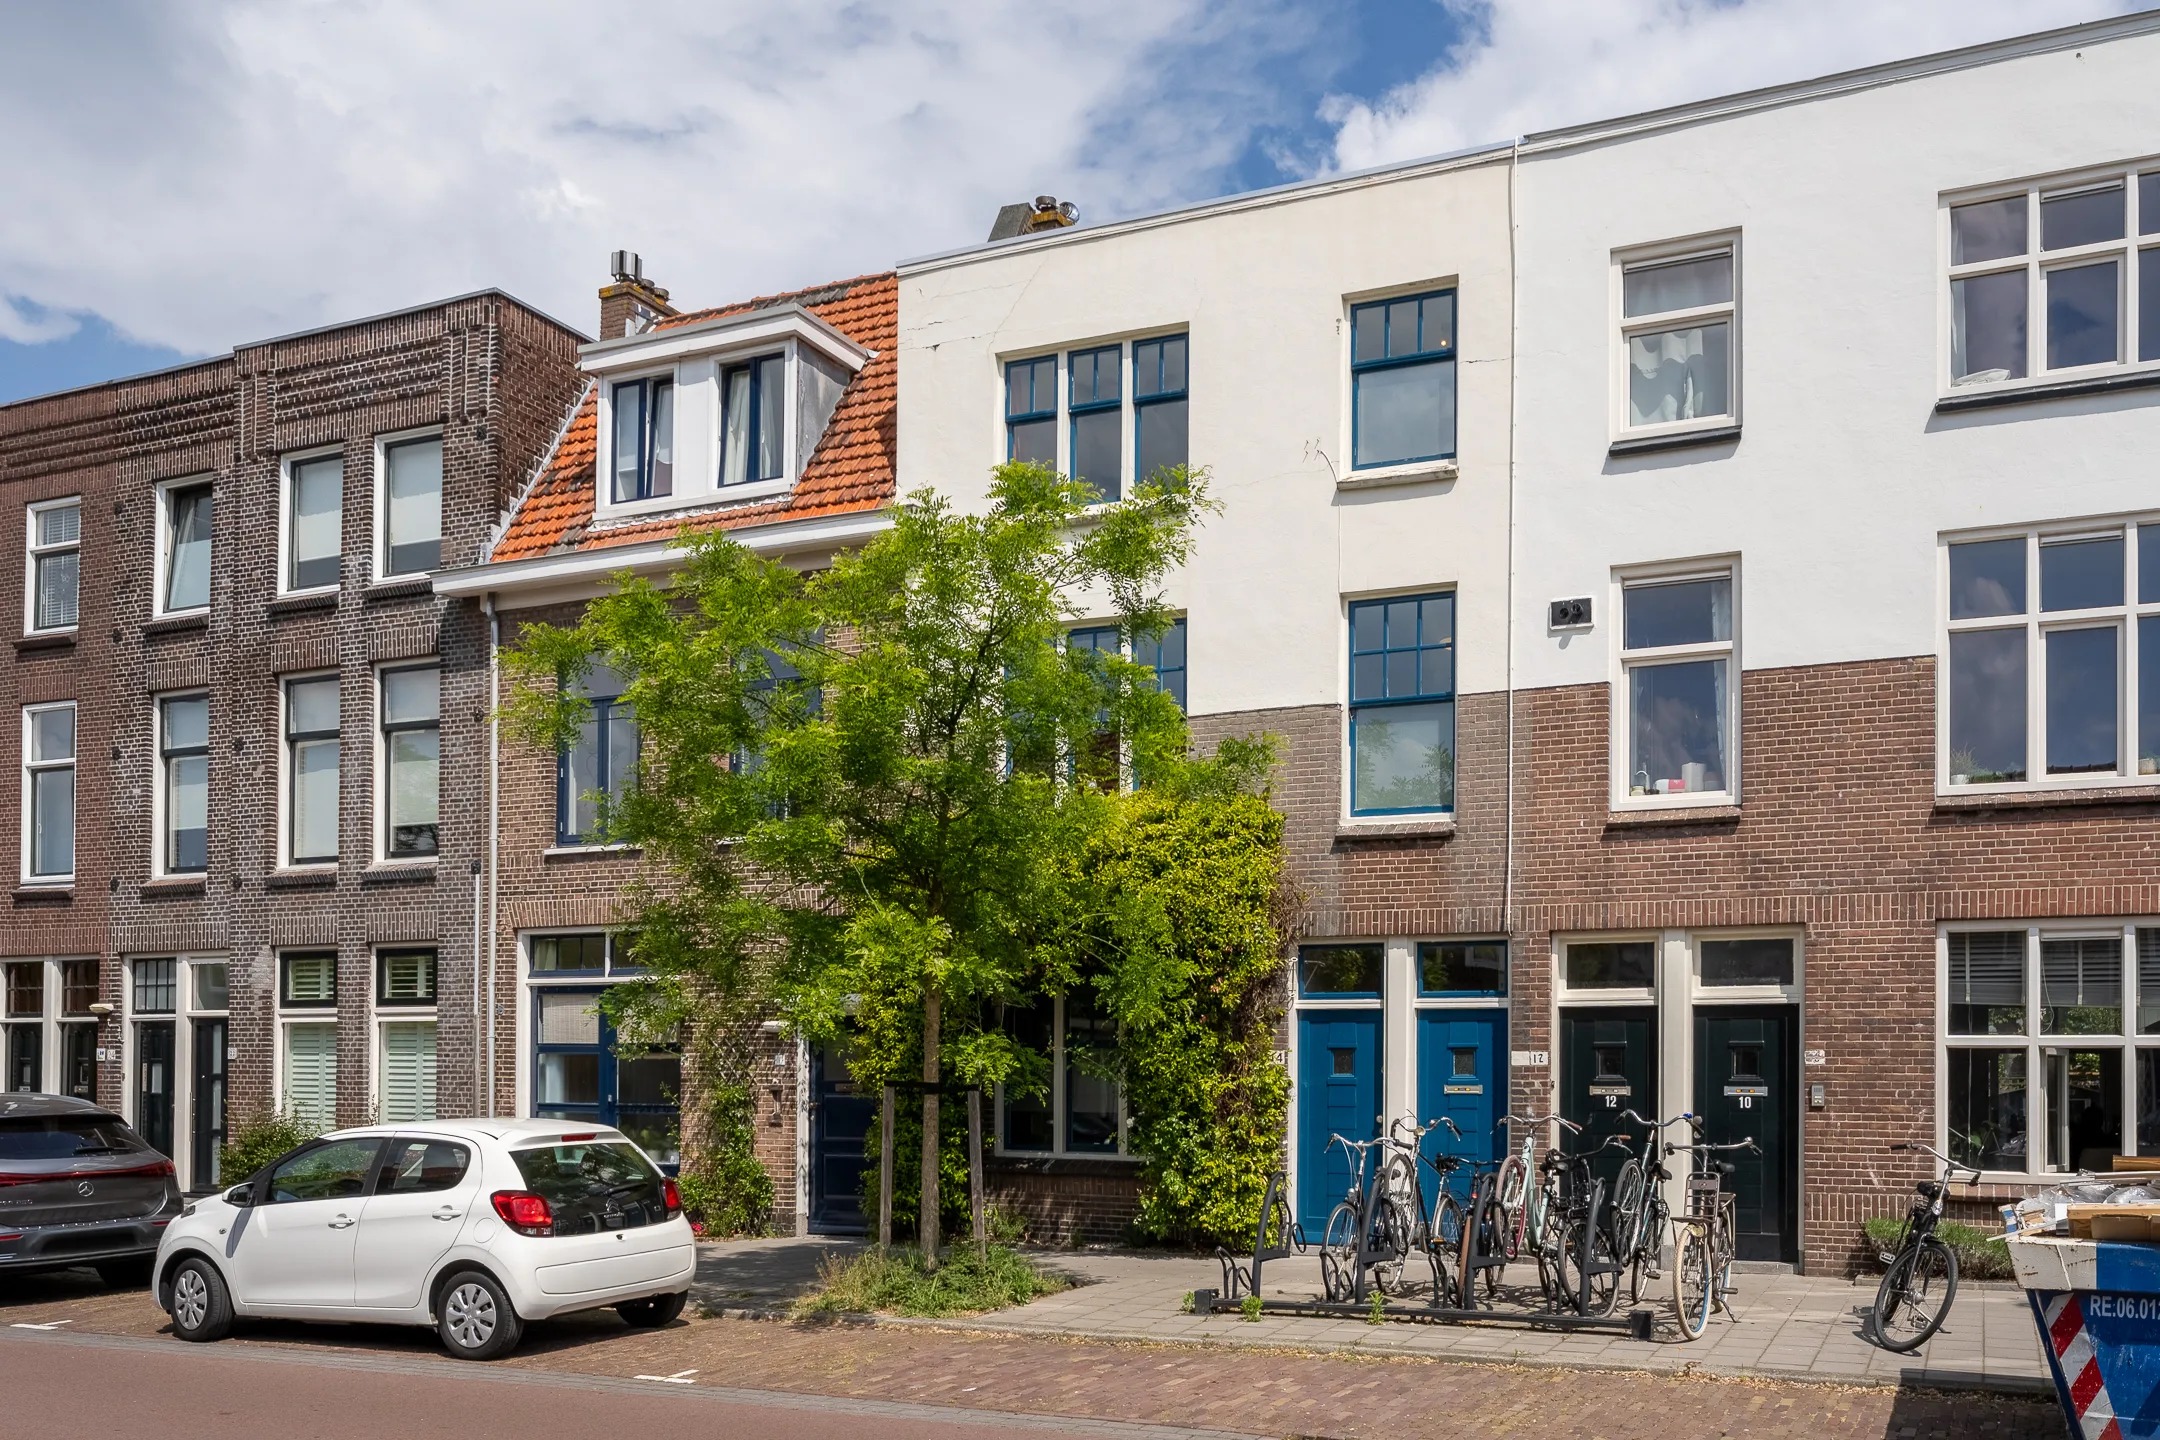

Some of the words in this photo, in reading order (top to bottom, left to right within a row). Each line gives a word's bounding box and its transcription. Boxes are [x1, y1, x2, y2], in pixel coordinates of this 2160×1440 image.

[1533, 1053, 1544, 1064] 12
[1605, 1095, 1617, 1108] 12
[1738, 1096, 1752, 1109] 10
[2090, 1295, 2160, 1320] RE:06.01
